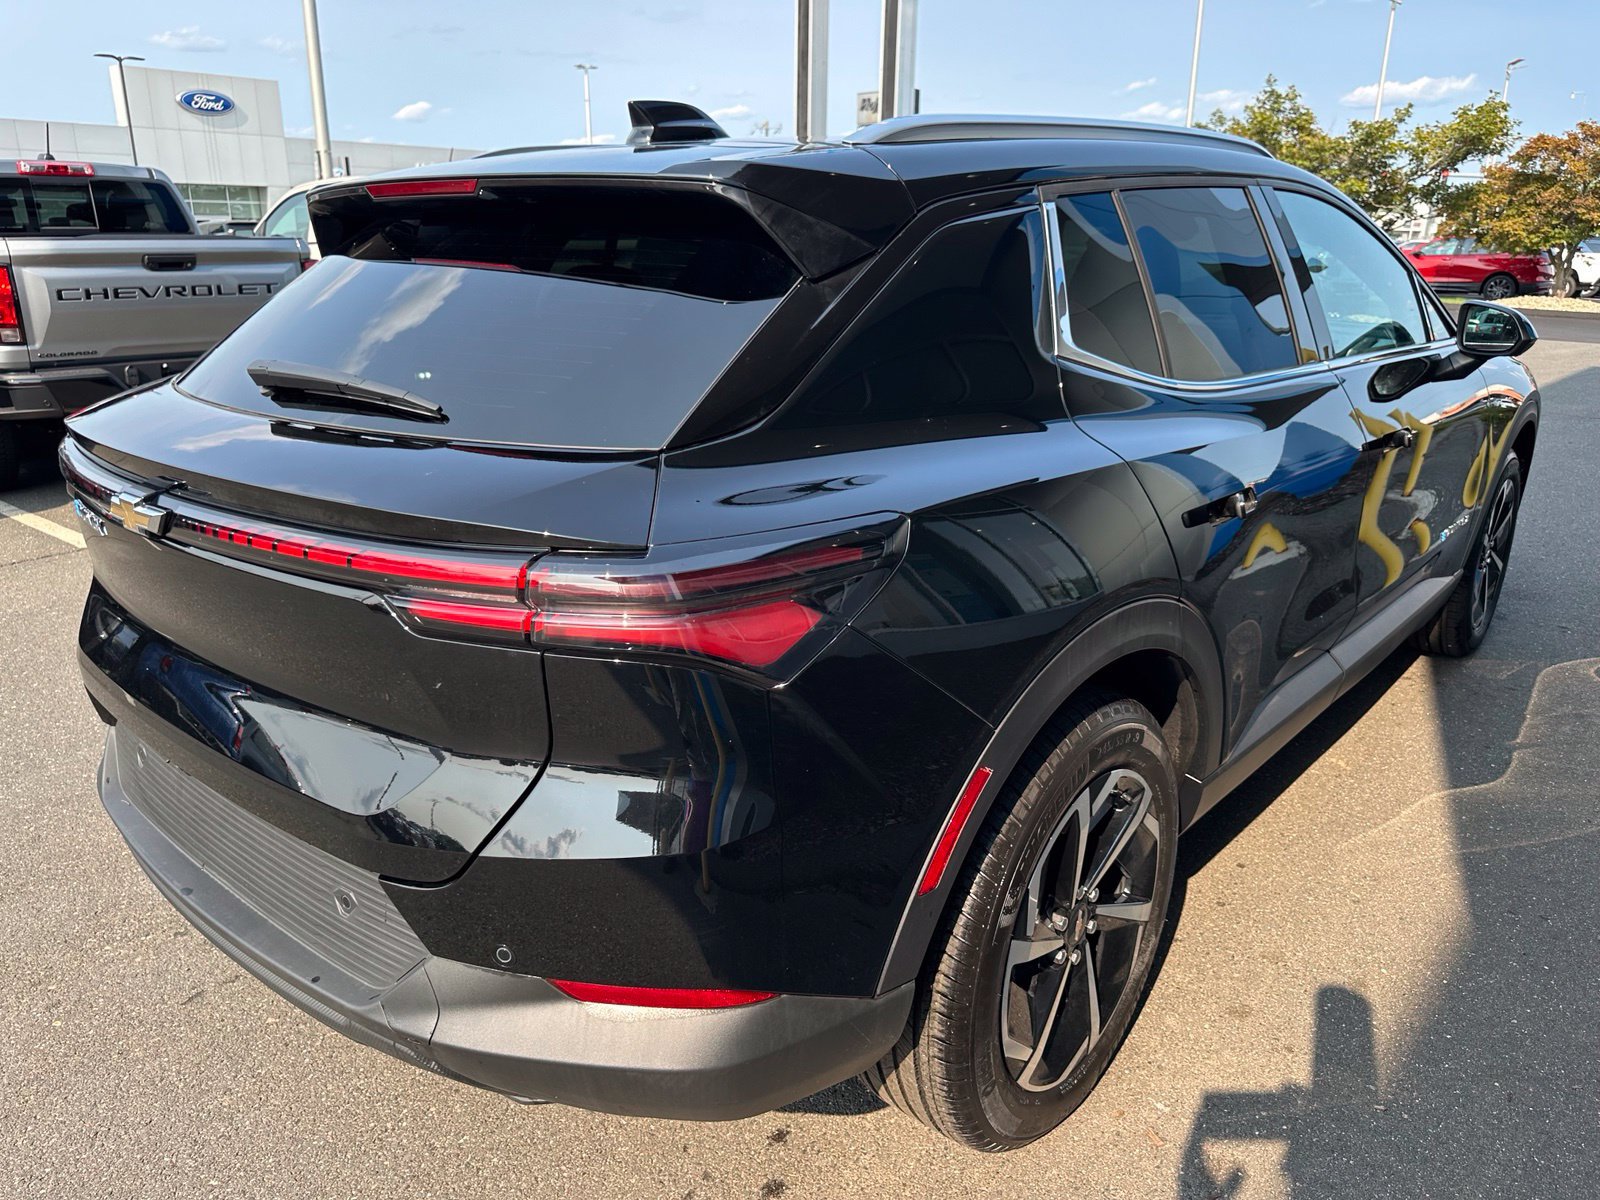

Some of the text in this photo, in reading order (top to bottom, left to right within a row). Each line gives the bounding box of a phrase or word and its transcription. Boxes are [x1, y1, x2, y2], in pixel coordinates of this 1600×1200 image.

[191, 94, 225, 111] Ford
[56, 282, 279, 302] CHEVROLET
[38, 350, 99, 360] COLORADO
